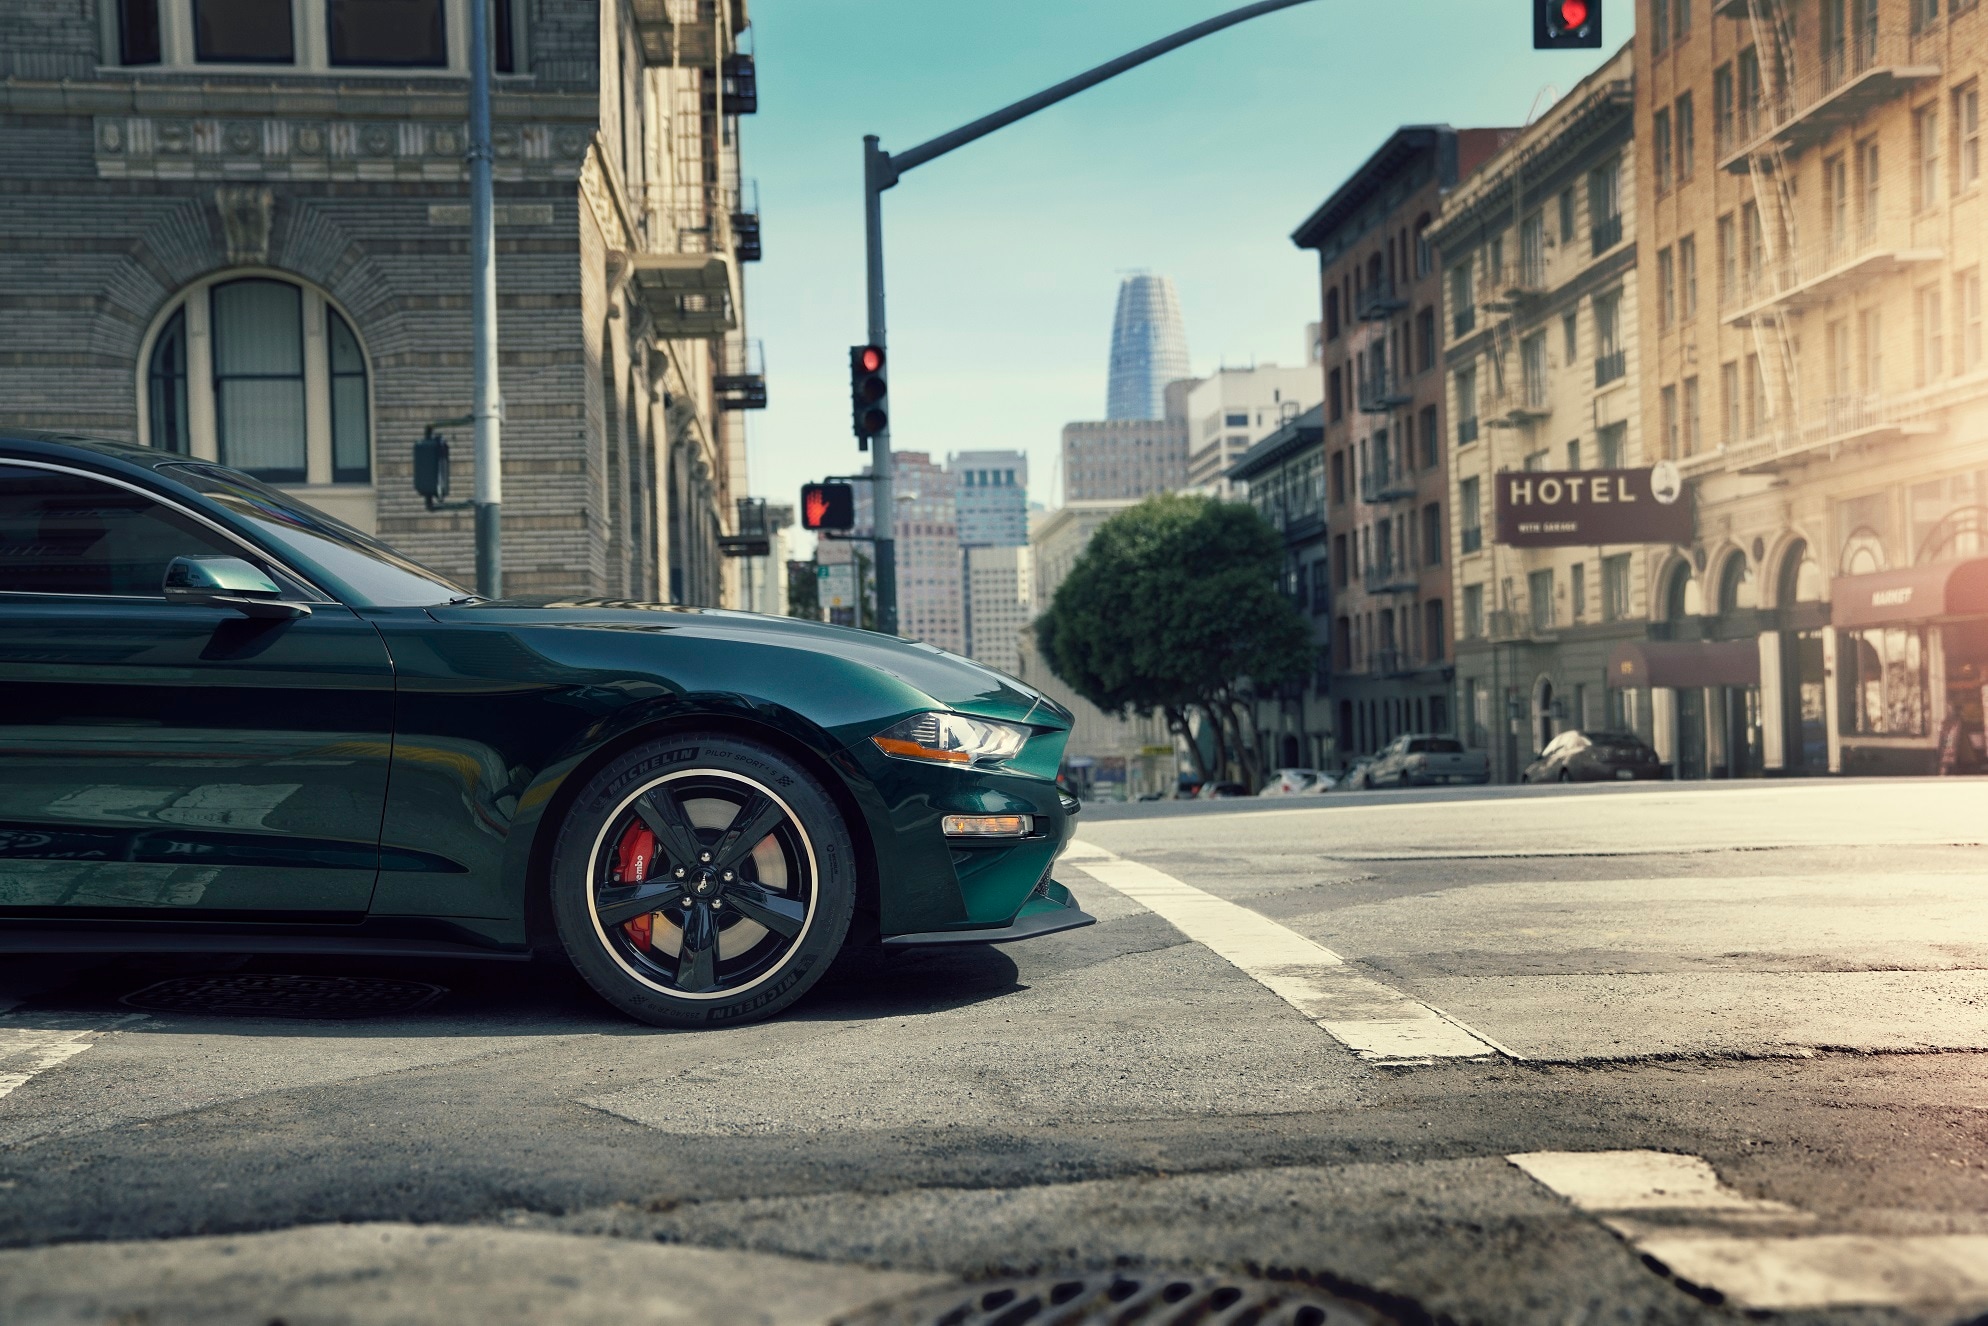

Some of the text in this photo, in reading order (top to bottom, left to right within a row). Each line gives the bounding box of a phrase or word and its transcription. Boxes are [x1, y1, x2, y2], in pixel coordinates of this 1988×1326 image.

[1510, 477, 1636, 505] HOTEL
[608, 749, 693, 795] MICHELIN
[705, 749, 733, 758] PILOT
[713, 973, 797, 1019] MICHELIN
